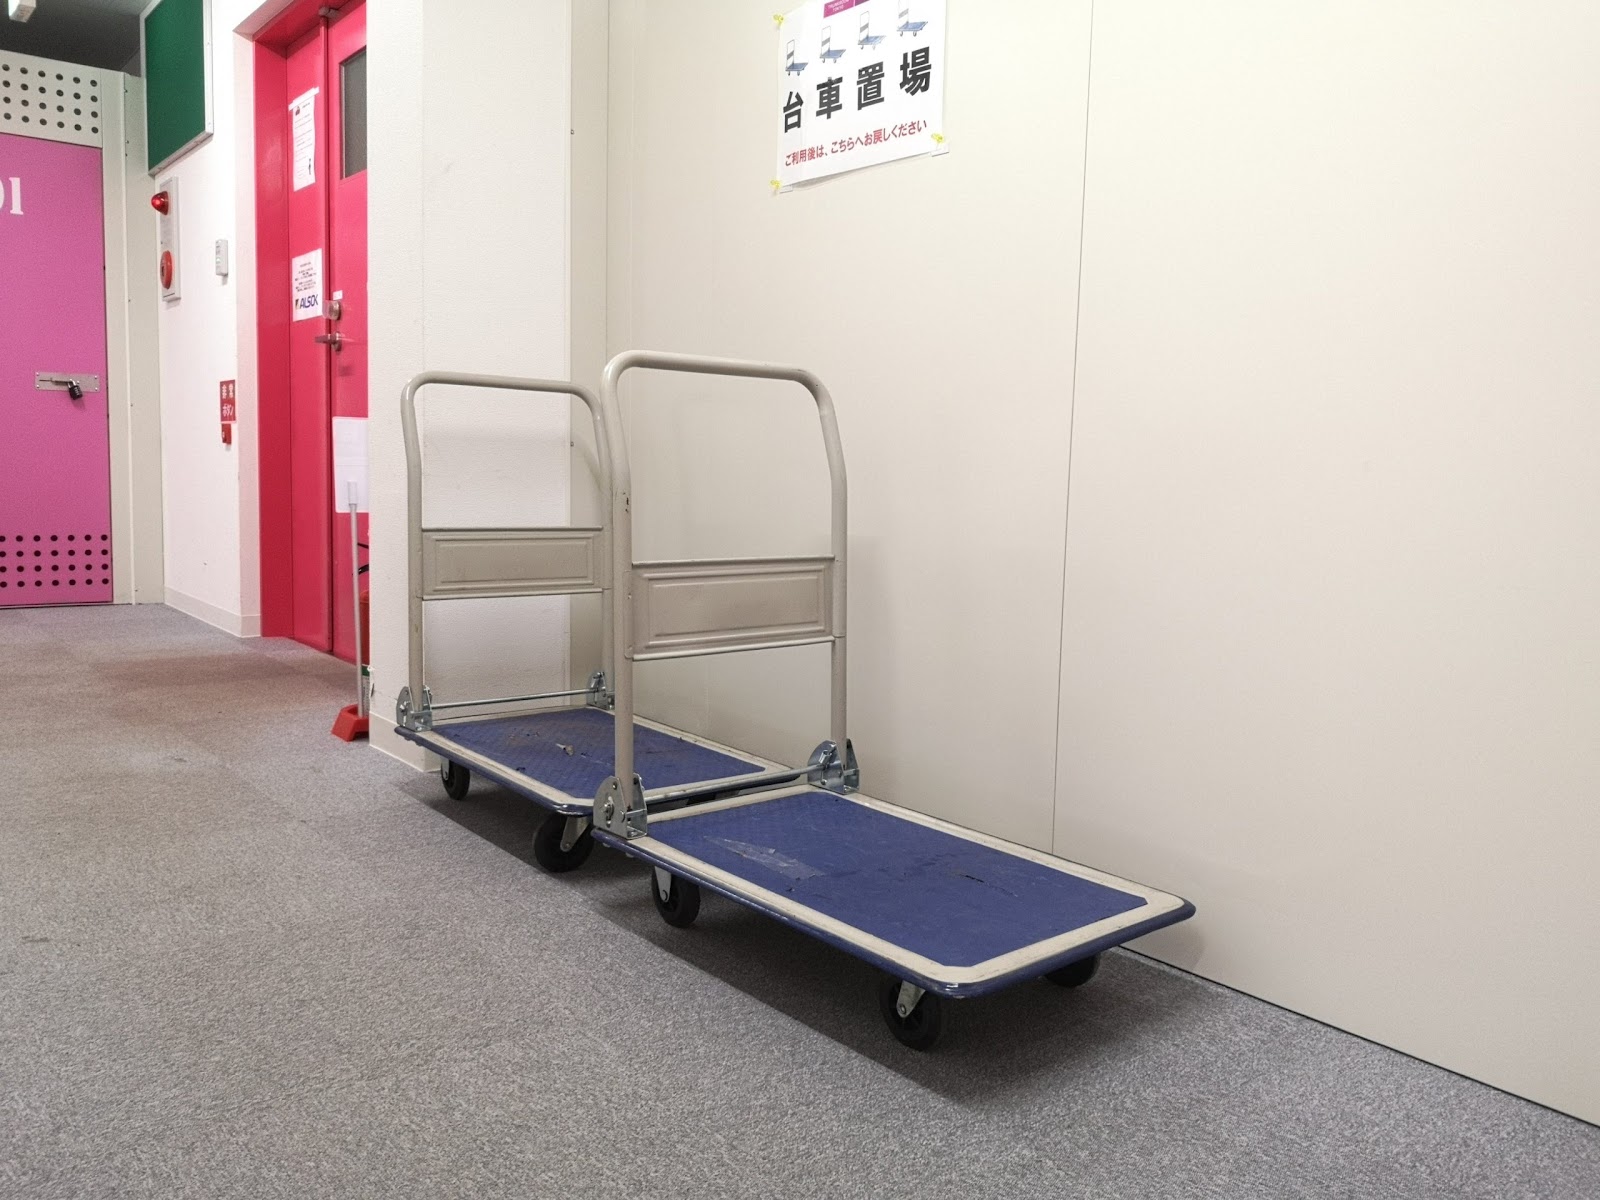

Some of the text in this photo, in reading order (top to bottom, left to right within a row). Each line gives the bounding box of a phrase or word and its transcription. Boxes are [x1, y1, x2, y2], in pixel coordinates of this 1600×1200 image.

[783, 46, 932, 133] 台車置場
[785, 120, 928, 167] ご利用後は、こちらへお戻しください
[0, 176, 24, 215] 1
